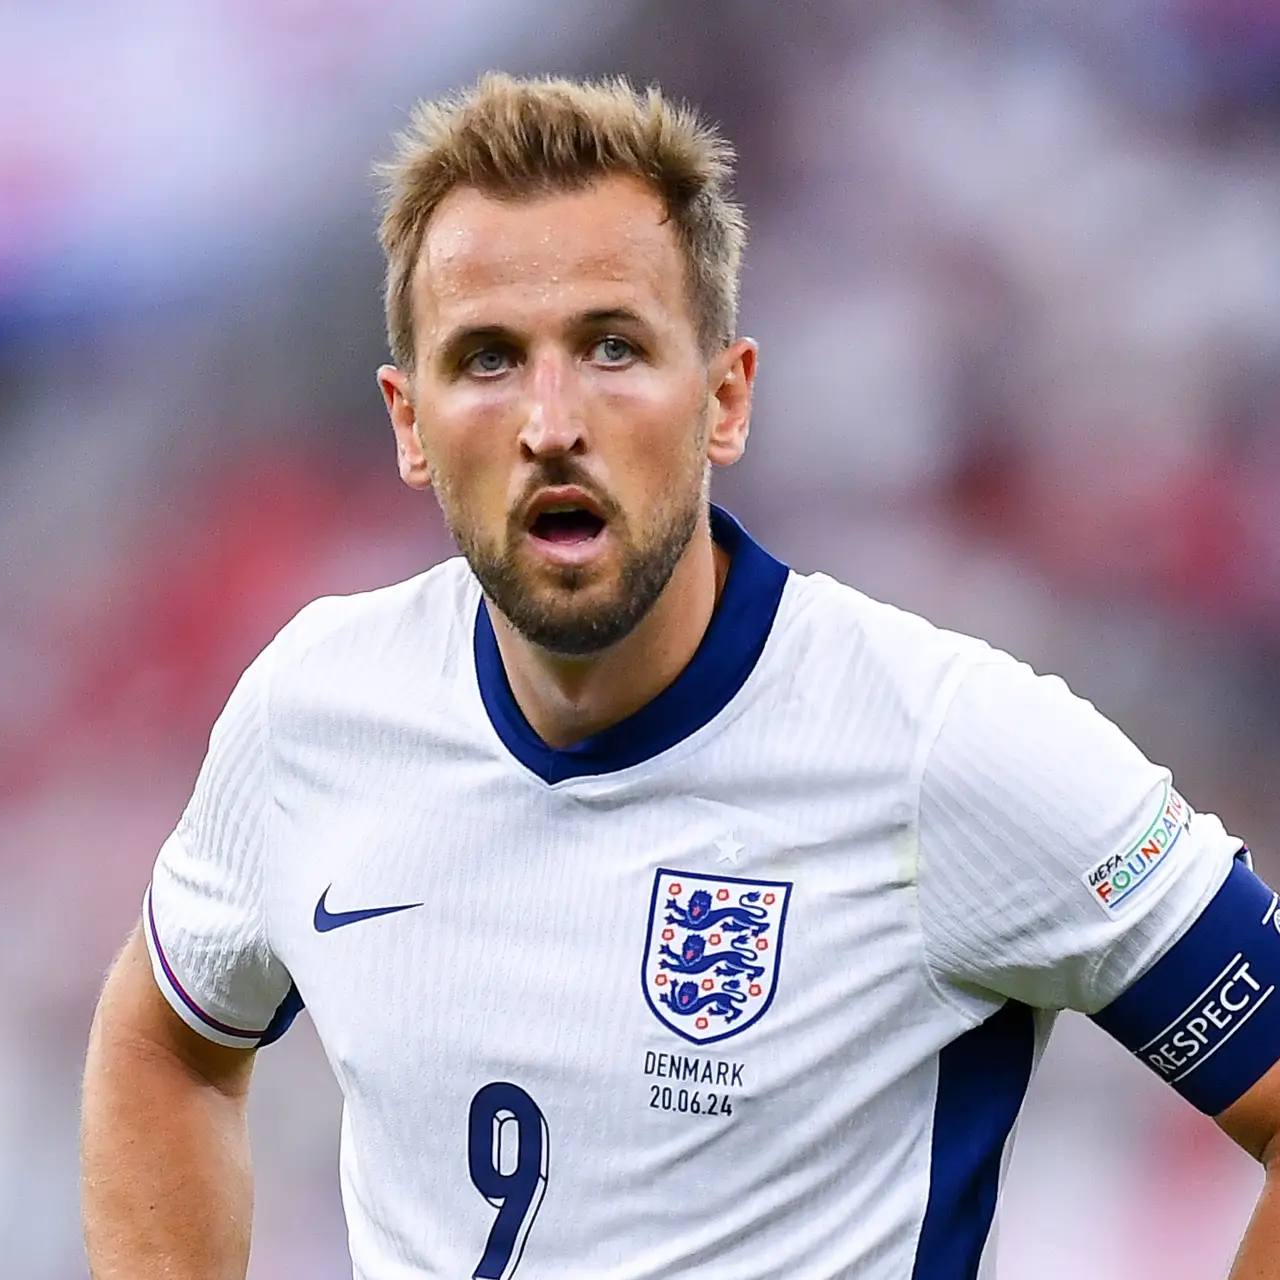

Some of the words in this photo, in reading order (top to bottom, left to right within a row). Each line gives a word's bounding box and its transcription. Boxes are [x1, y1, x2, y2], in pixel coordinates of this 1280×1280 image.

[1095, 790, 1183, 904] FOUNDATIO
[1087, 853, 1124, 887] UEFA
[1148, 961, 1261, 1075] RESPECT
[643, 1050, 746, 1088] DENMARK
[648, 1084, 733, 1117] 20.06.24
